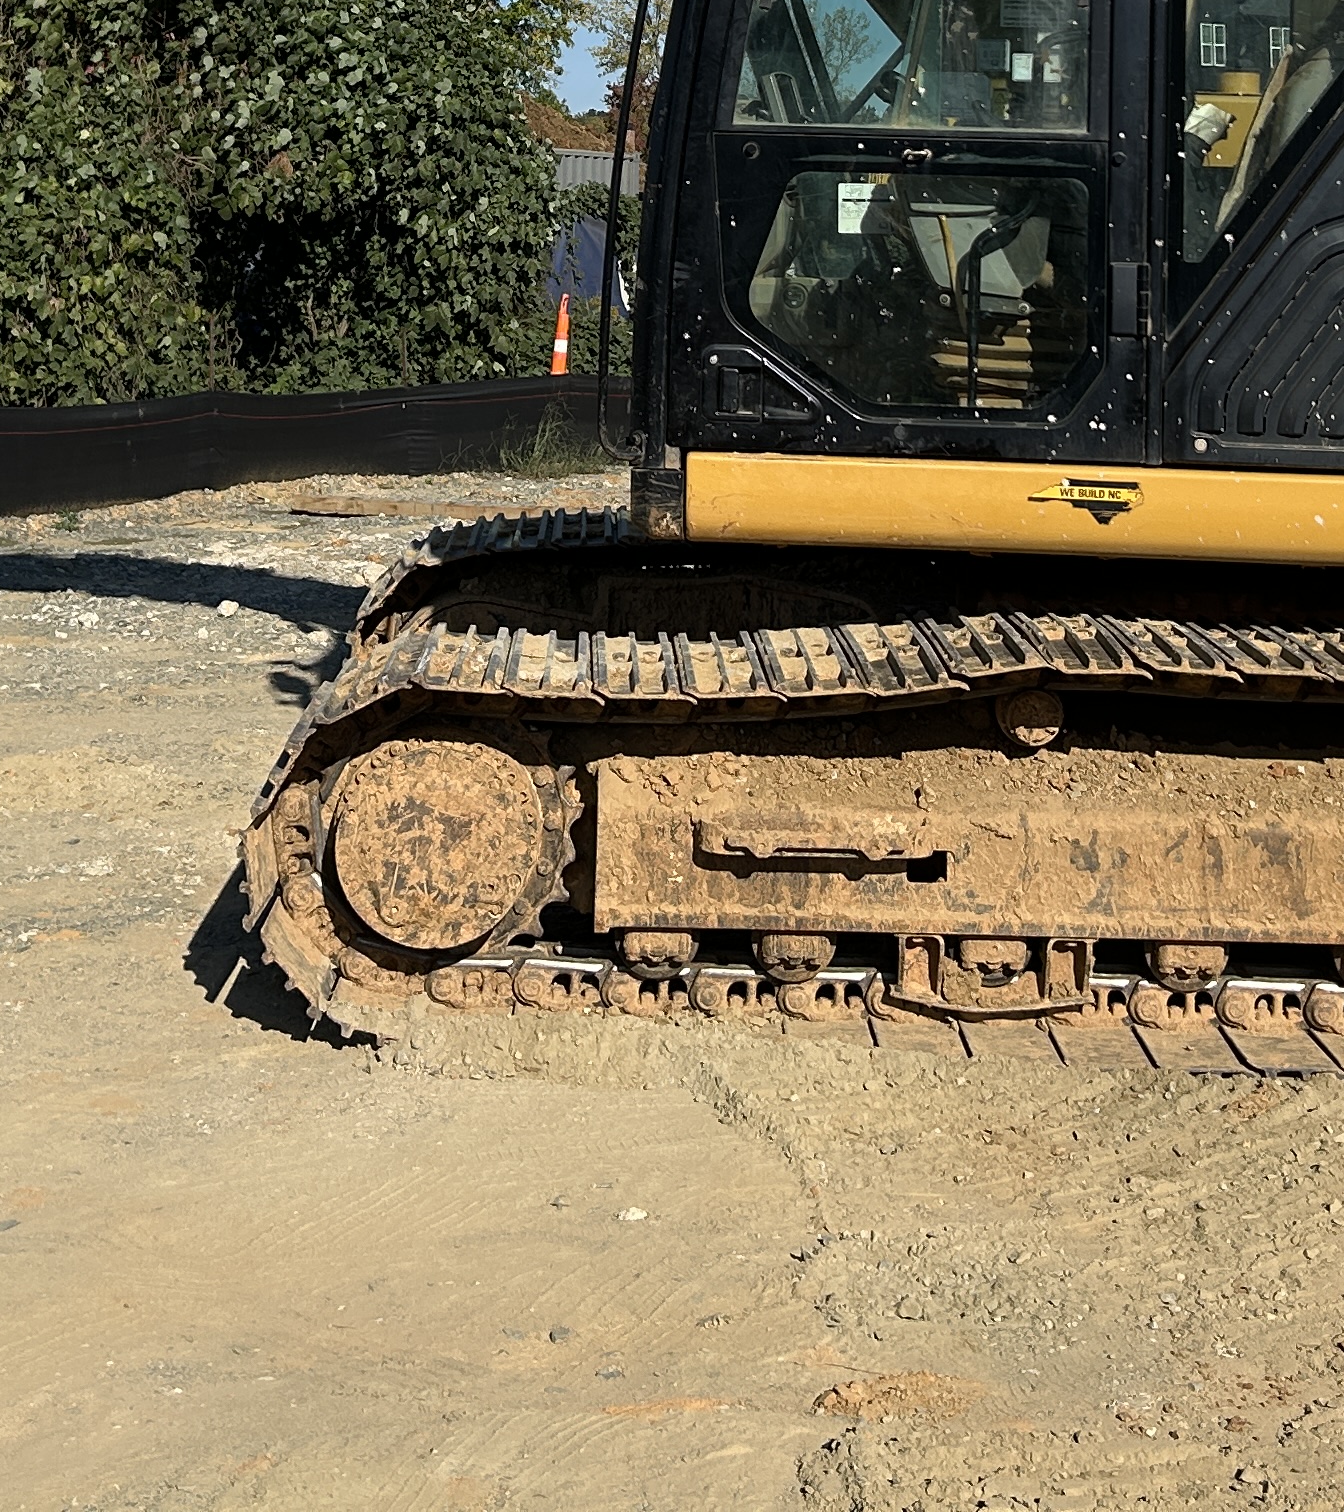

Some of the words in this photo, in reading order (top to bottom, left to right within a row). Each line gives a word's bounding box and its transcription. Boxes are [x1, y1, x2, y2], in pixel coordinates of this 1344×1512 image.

[1060, 487, 1075, 497] WE
[1078, 488, 1105, 499] BUILD
[1108, 489, 1122, 499] NC
